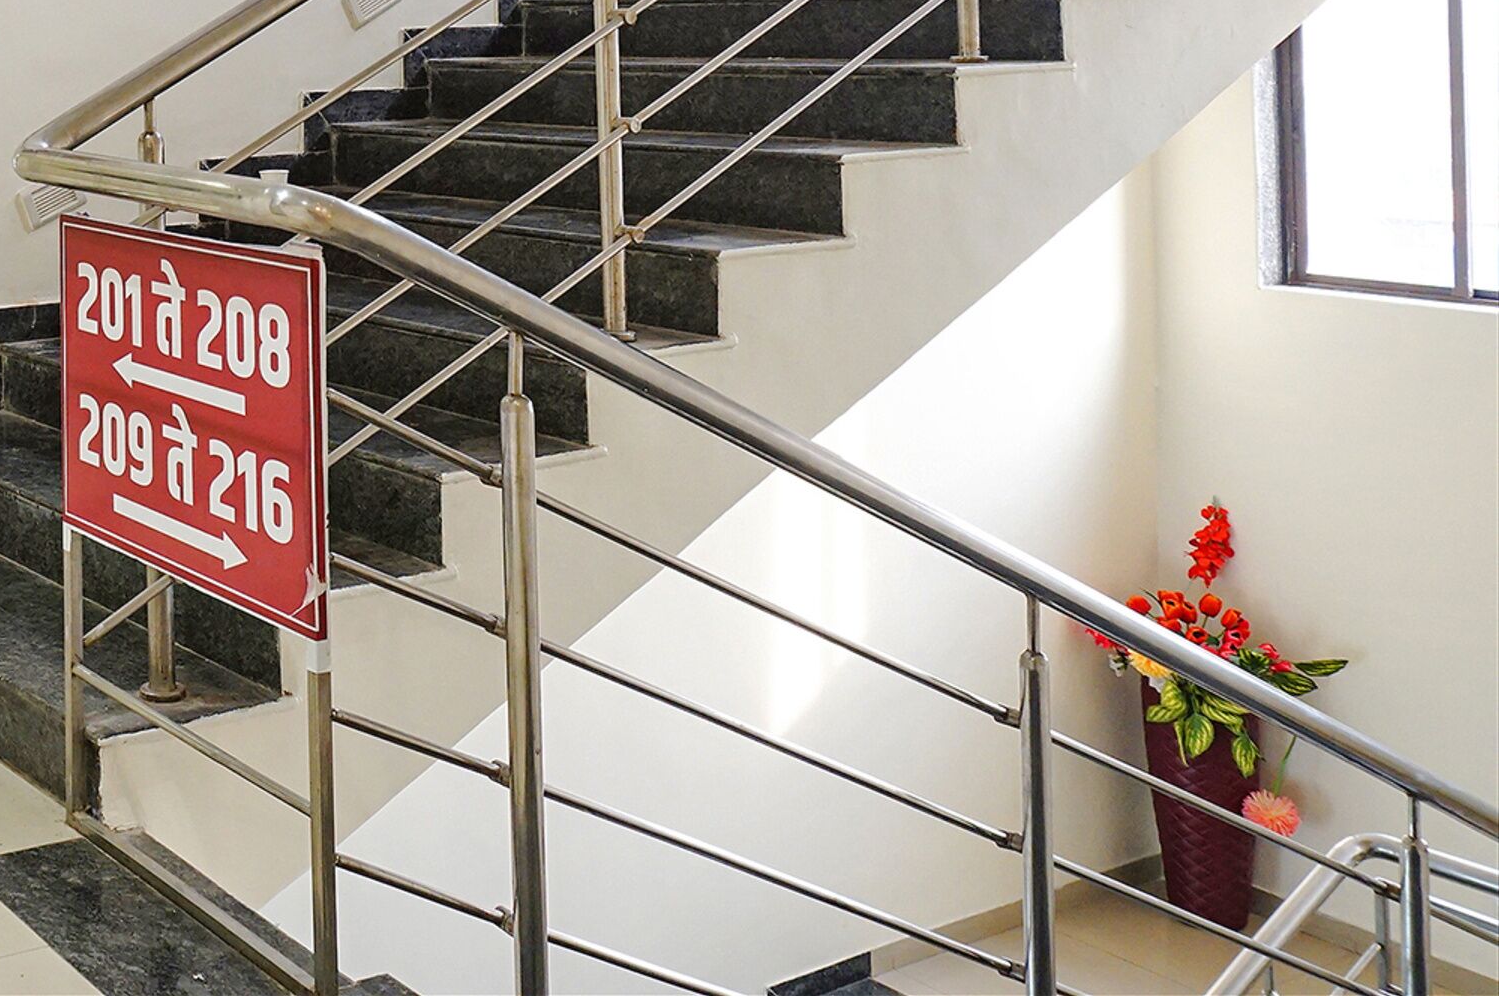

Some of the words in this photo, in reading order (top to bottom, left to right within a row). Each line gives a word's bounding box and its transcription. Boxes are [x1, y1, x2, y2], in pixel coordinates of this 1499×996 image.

[77, 262, 143, 348] 201
[151, 258, 187, 358] ते
[196, 289, 291, 388] 208
[78, 393, 154, 486] 209
[162, 403, 198, 506] ते
[209, 438, 294, 544] 216
